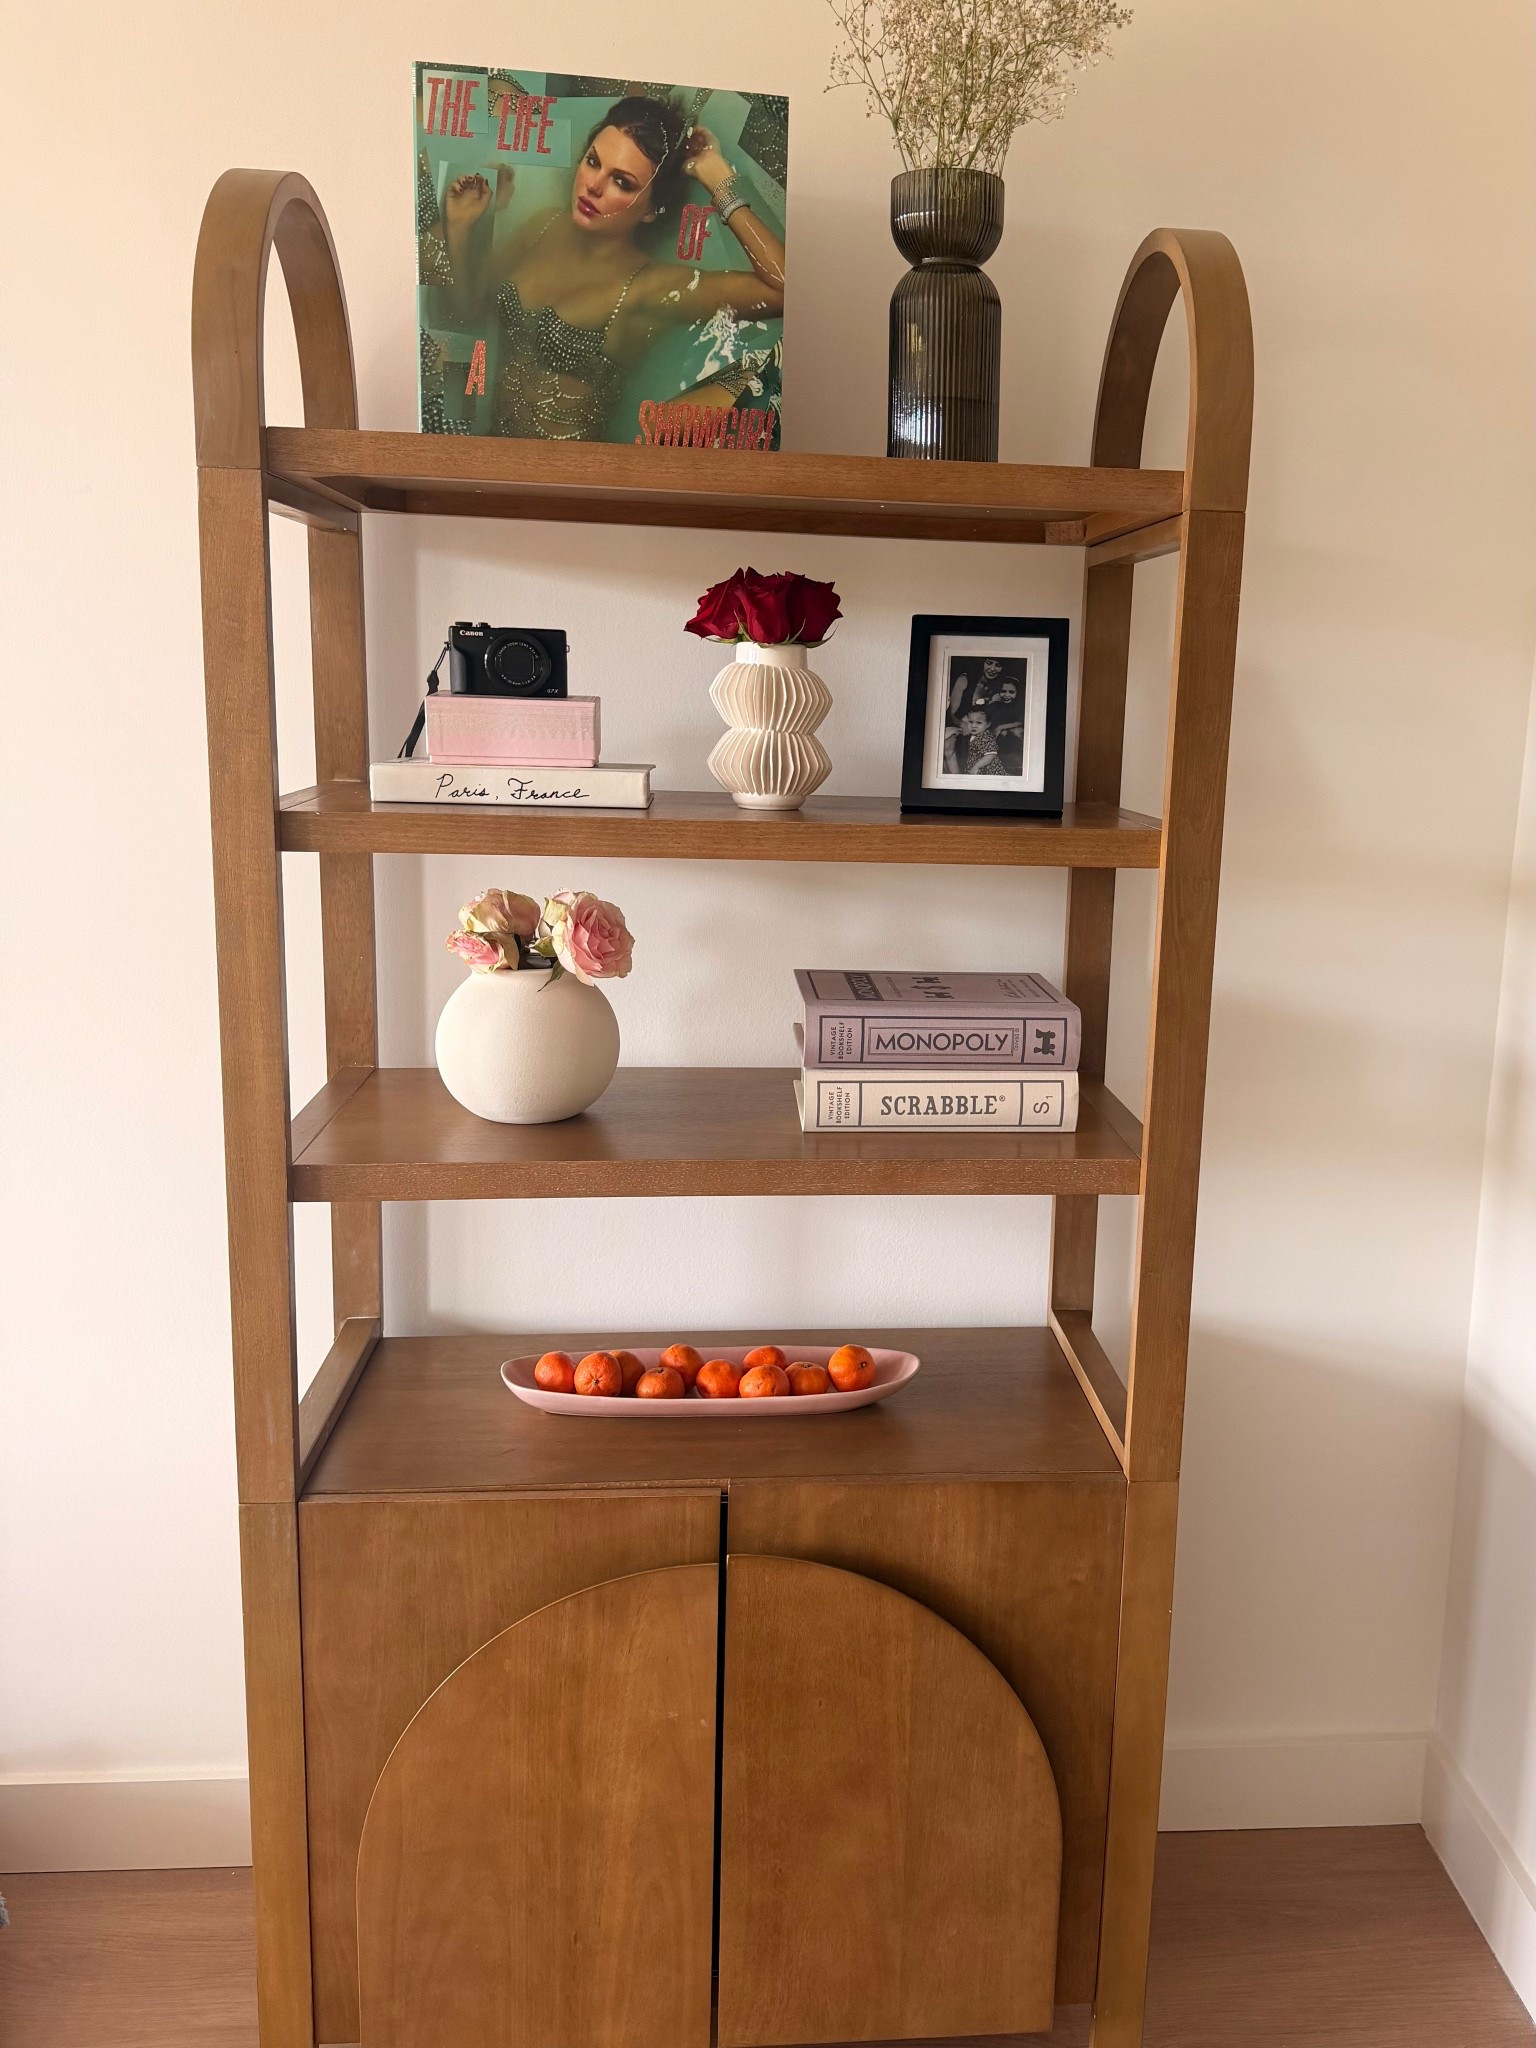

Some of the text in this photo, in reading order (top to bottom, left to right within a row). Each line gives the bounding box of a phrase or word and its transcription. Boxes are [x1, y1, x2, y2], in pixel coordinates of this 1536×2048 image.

[426, 77, 480, 138] THE
[497, 93, 557, 154] LIFE
[676, 203, 718, 260] OF
[465, 340, 486, 396] A
[635, 400, 775, 451] SHOWGIRL
[507, 778, 590, 800] France
[829, 1026, 837, 1056] VINTAGE
[875, 1032, 1009, 1051] MONOPOLY
